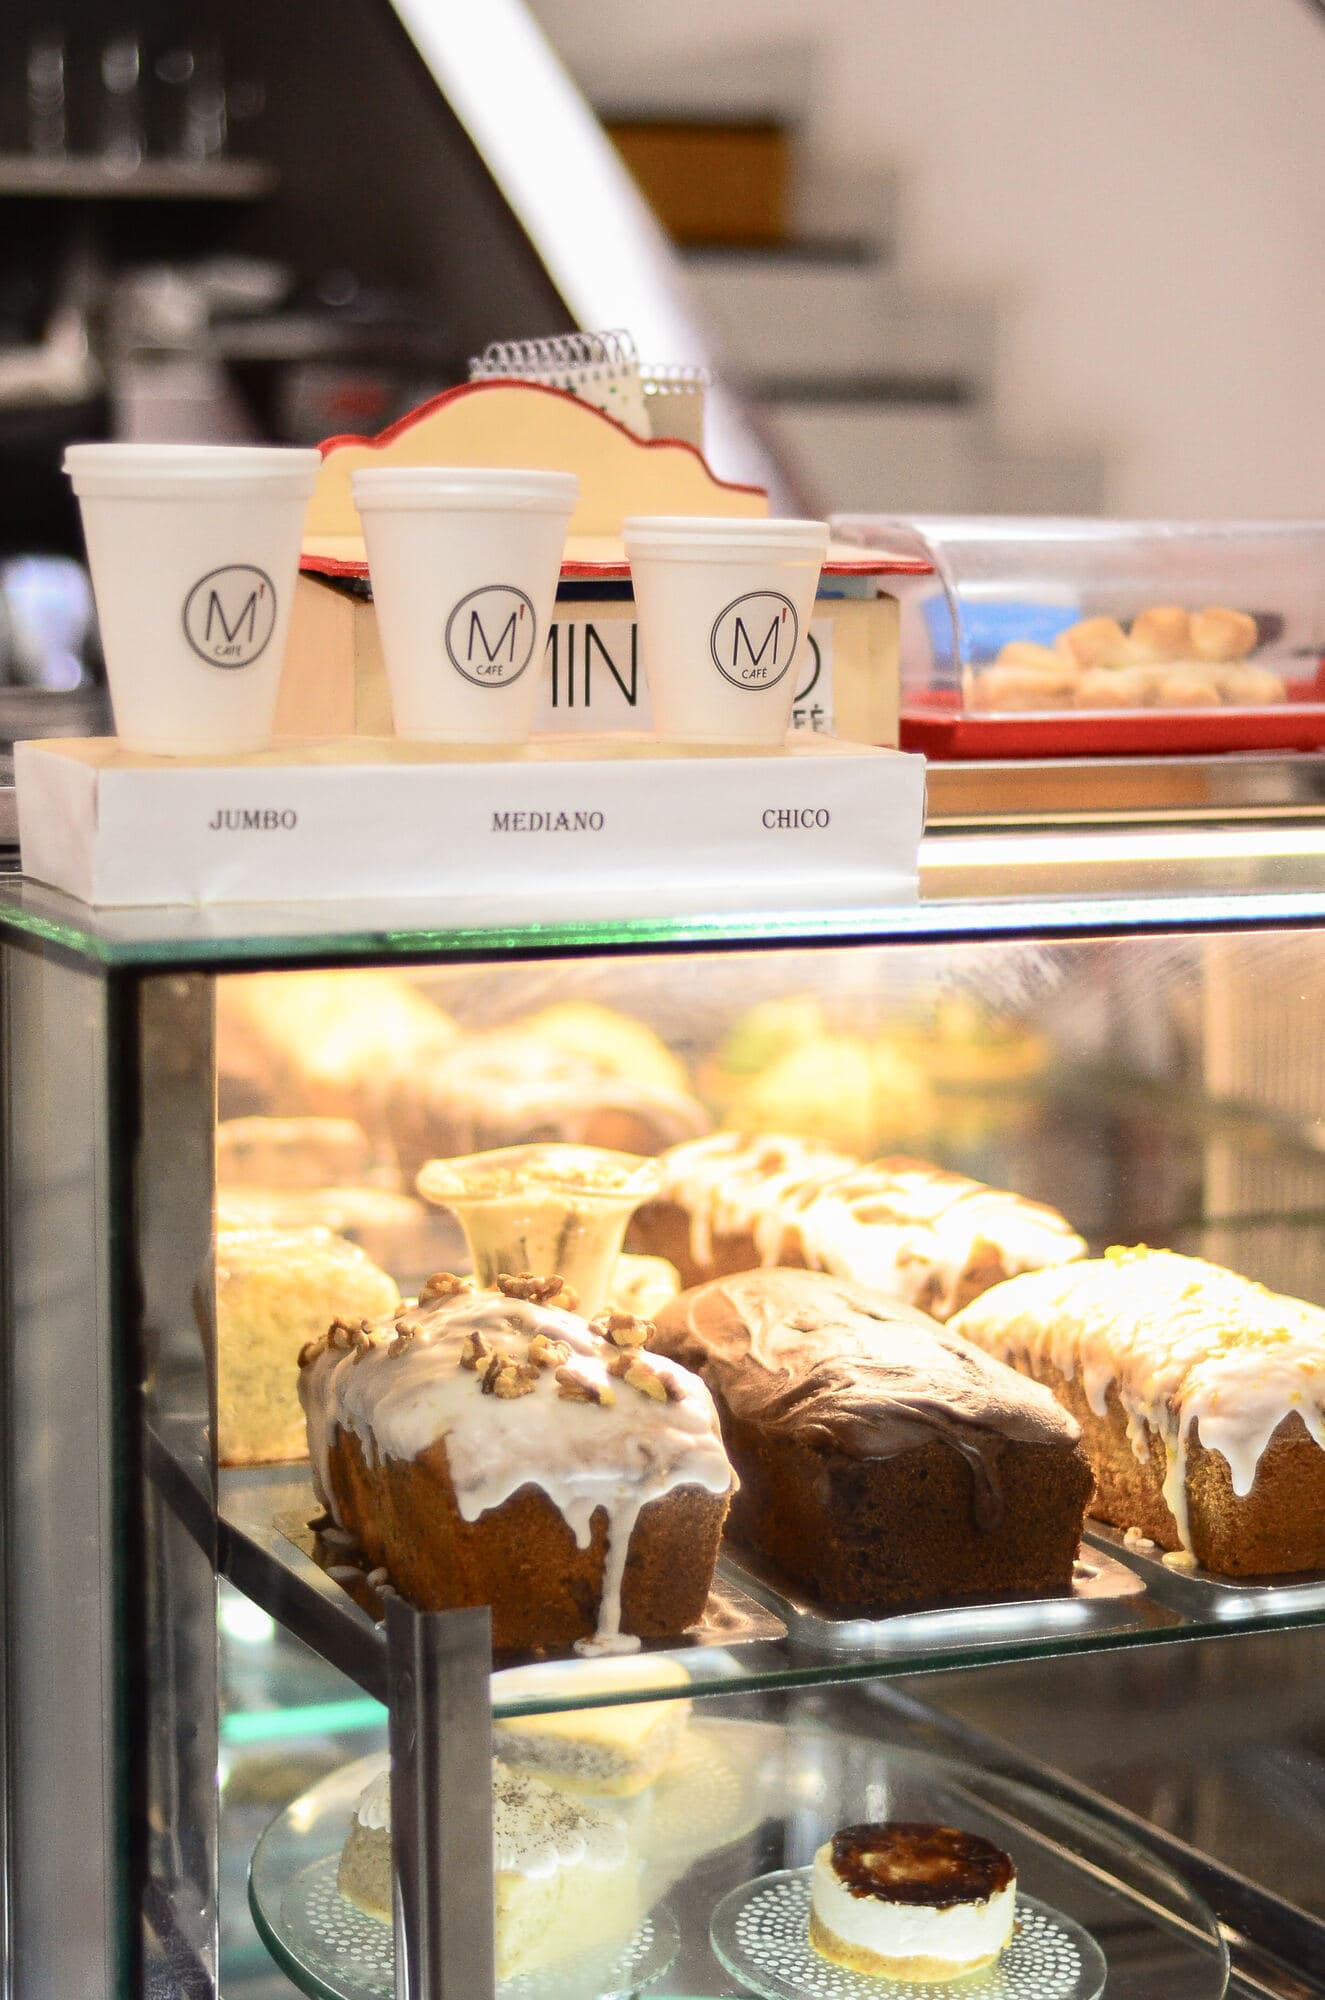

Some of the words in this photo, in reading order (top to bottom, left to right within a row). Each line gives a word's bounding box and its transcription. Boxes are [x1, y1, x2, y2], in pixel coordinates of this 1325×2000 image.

[741, 667, 768, 680] CAFÉ
[208, 809, 297, 831] JUMBO
[492, 810, 605, 832] MEDIANO
[761, 808, 831, 829] CHICO
